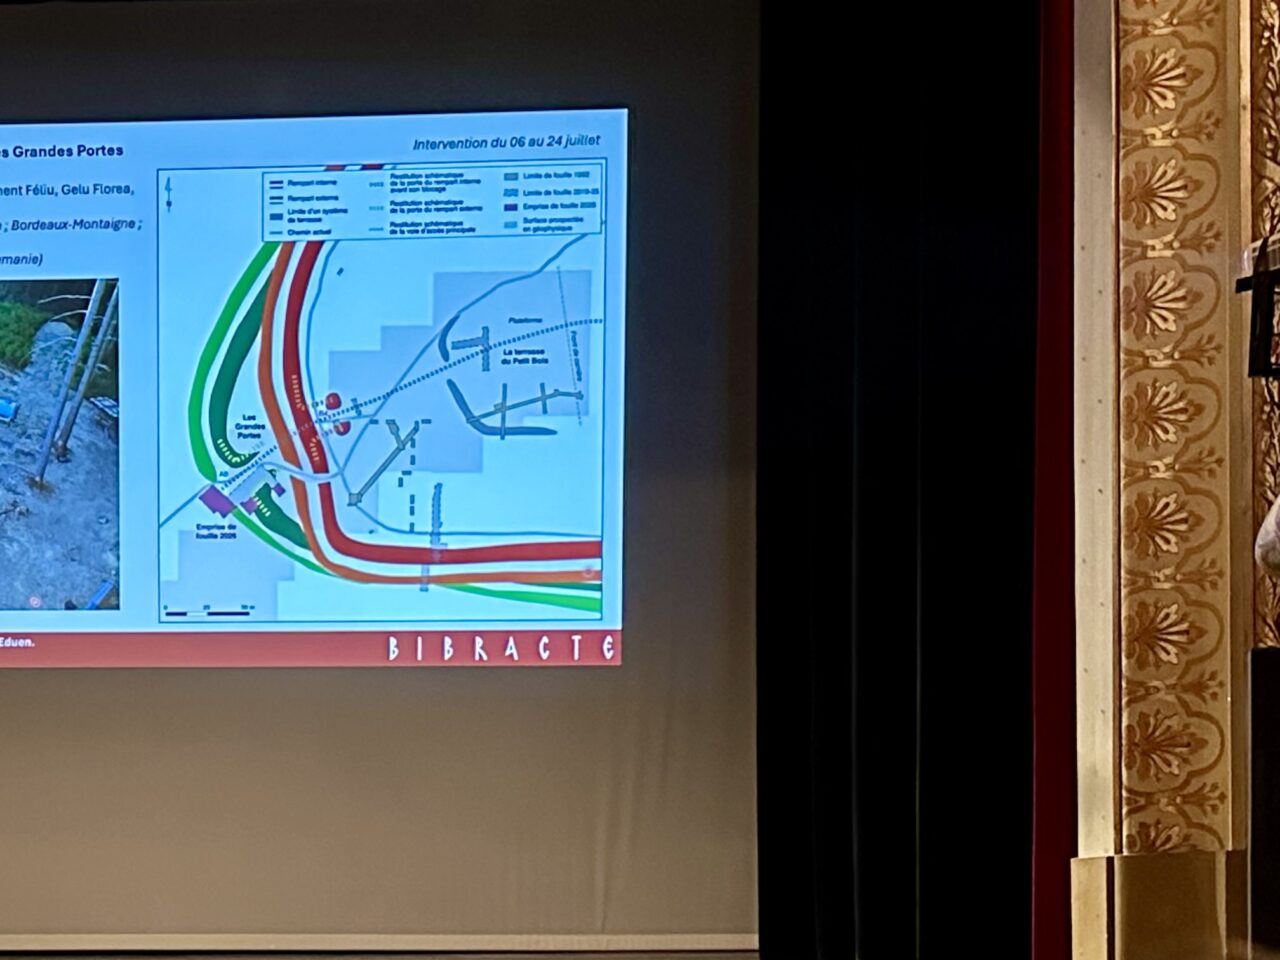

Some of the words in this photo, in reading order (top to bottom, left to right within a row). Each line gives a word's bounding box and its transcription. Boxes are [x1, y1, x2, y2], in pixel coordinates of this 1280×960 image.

[413, 137, 488, 150] Intervention
[491, 137, 507, 148] du
[510, 137, 525, 148] 06
[528, 138, 544, 148] au
[546, 135, 562, 147] 24
[564, 134, 600, 149] juillet
[13, 144, 73, 158] Grandes
[77, 144, 124, 156] Portes
[61, 183, 90, 196] Gelu
[11, 217, 136, 232] Bordeaux-Montaigne
[388, 635, 614, 661] BIBRACTE
